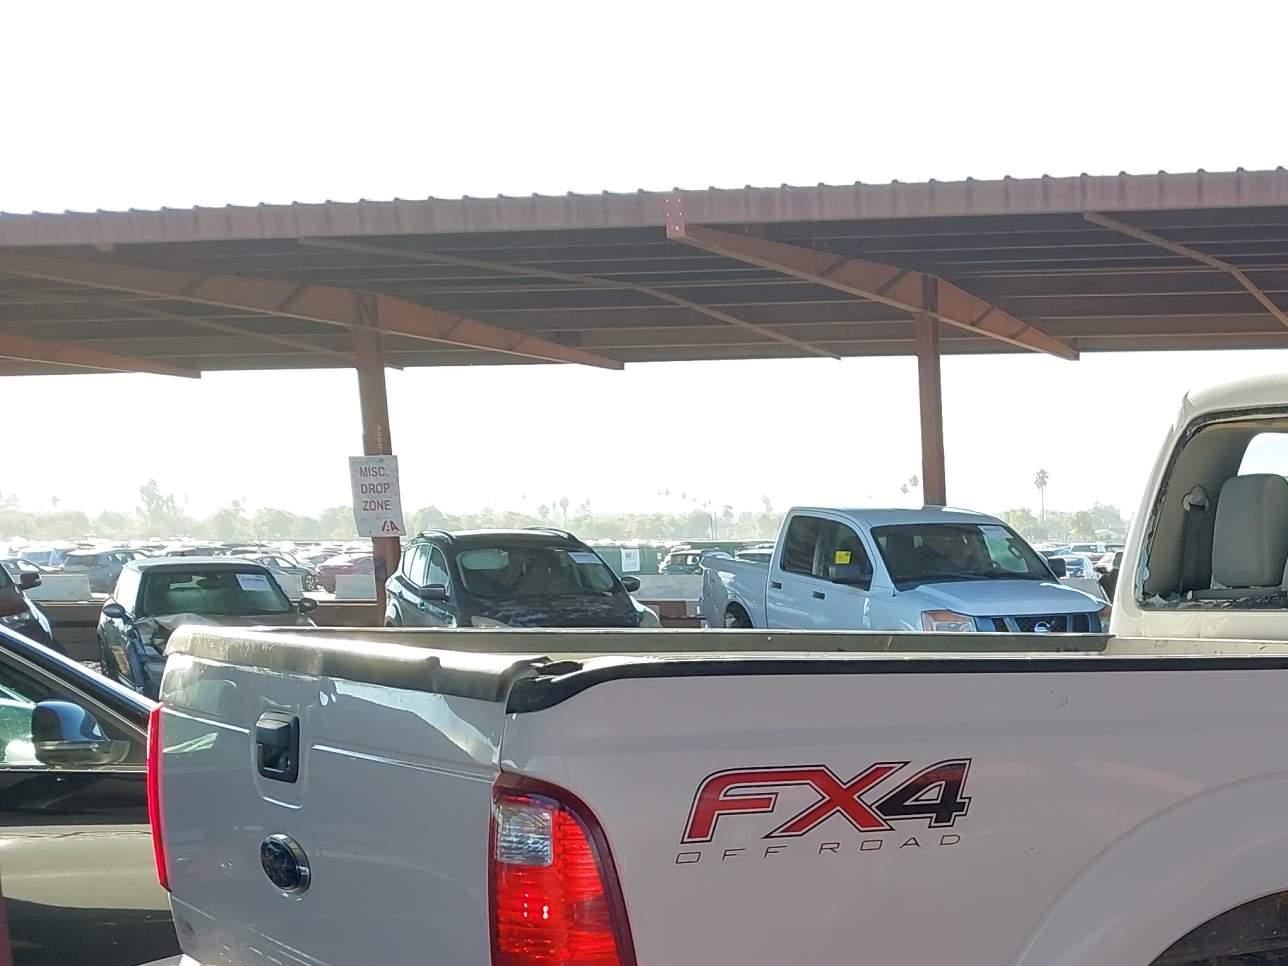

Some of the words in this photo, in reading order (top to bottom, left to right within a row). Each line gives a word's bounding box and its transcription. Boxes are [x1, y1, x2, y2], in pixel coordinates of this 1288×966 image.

[359, 466, 389, 477] MISC.
[360, 483, 390, 494] DROP
[362, 500, 391, 511] ZONE
[680, 757, 973, 845] FX4
[675, 844, 789, 865] OFF
[817, 834, 962, 856] ROAD
